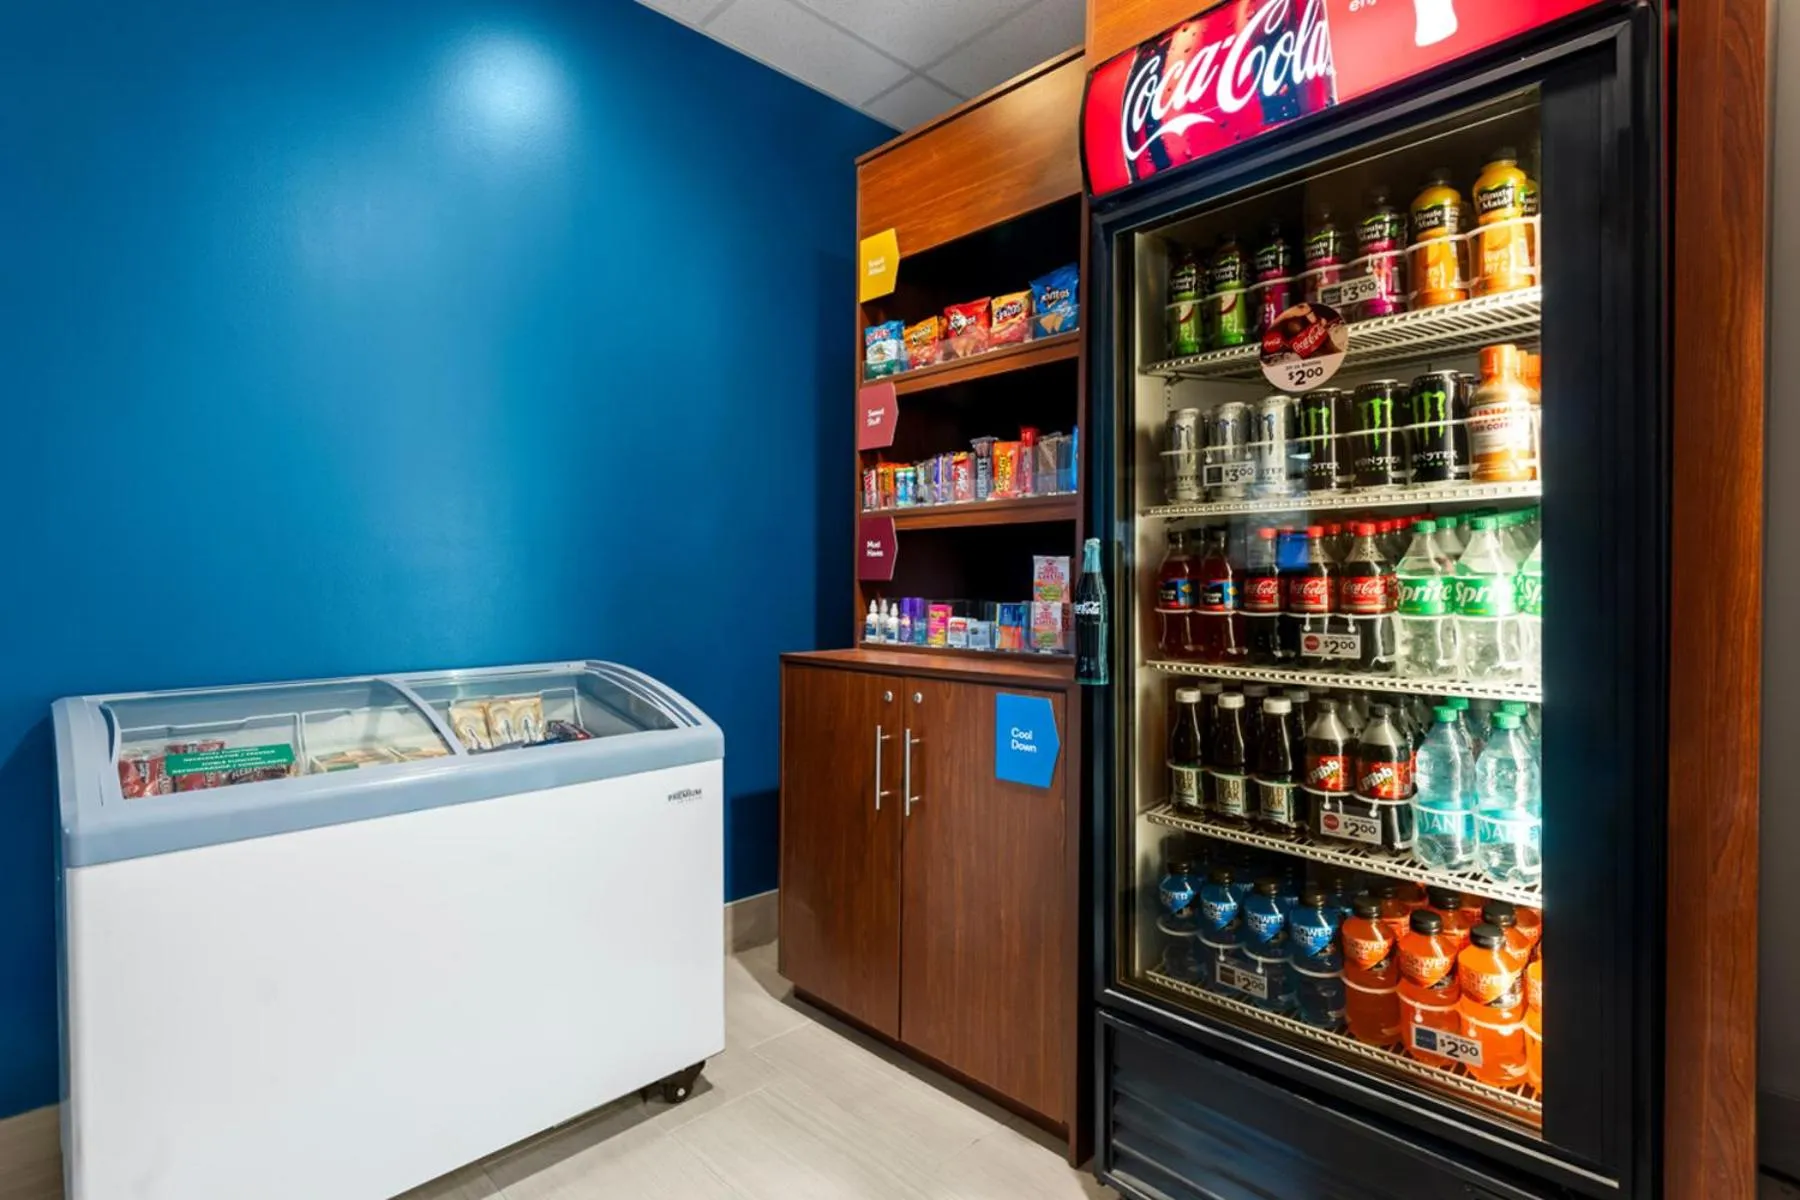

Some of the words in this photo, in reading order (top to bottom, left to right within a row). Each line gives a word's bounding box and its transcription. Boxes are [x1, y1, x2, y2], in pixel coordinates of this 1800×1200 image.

[1121, 0, 1334, 160] Coca-Cola
[1397, 577, 1453, 605] Sprite
[1011, 727, 1032, 740] Cool
[1011, 739, 1037, 753] Down
